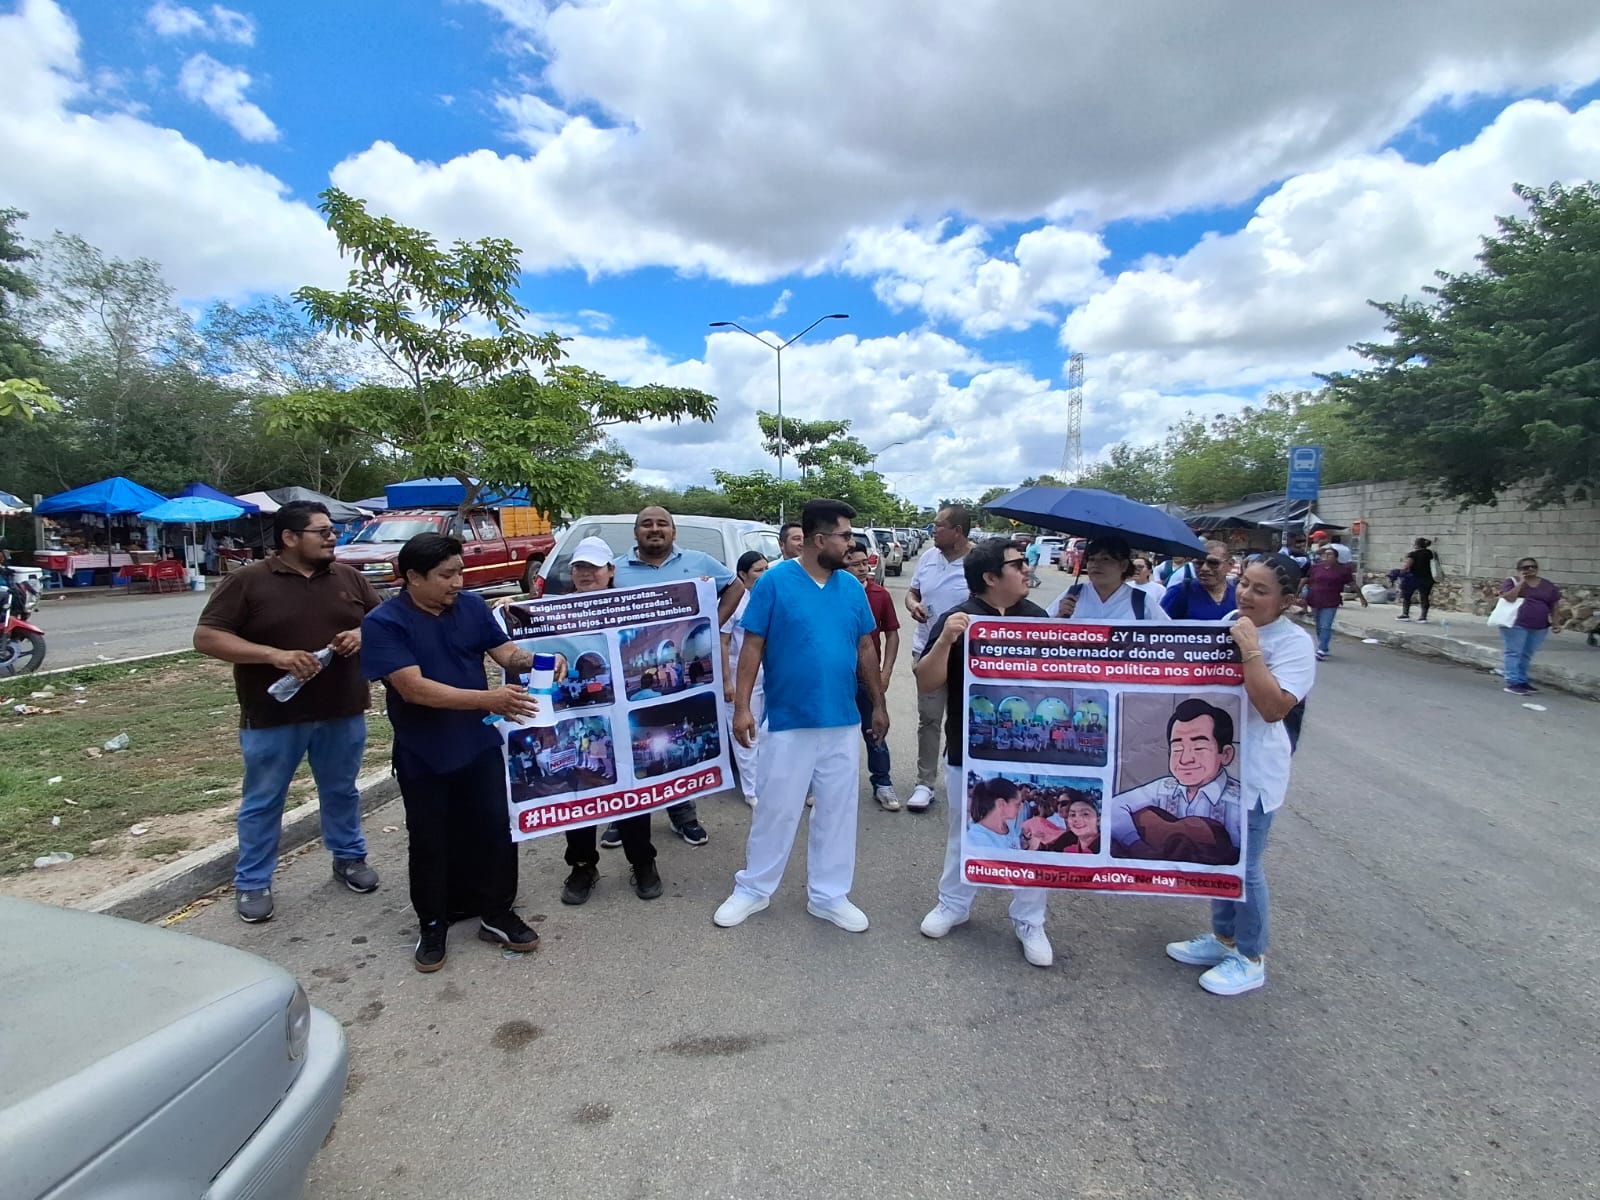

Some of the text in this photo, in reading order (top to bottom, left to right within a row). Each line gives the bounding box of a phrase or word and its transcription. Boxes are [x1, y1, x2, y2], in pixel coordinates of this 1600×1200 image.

[530, 603, 573, 614] Exigimos
[573, 597, 612, 609] regresar
[547, 610, 566, 621] más
[567, 605, 631, 619] reubicaciones
[631, 598, 673, 610] forzadas!
[513, 605, 692, 636] Mi familia esta lejos. La promesa tambien
[978, 628, 1233, 646] 2 años reubicados. ¿Y la promesa de
[980, 645, 1233, 663] regresar gobernador dónde quedo?
[970, 658, 1038, 672] Pandemia
[1041, 662, 1101, 674] contrato
[1105, 662, 1160, 676] política
[1164, 666, 1190, 677] nos
[525, 773, 715, 827] #HuachoDaLaCara
